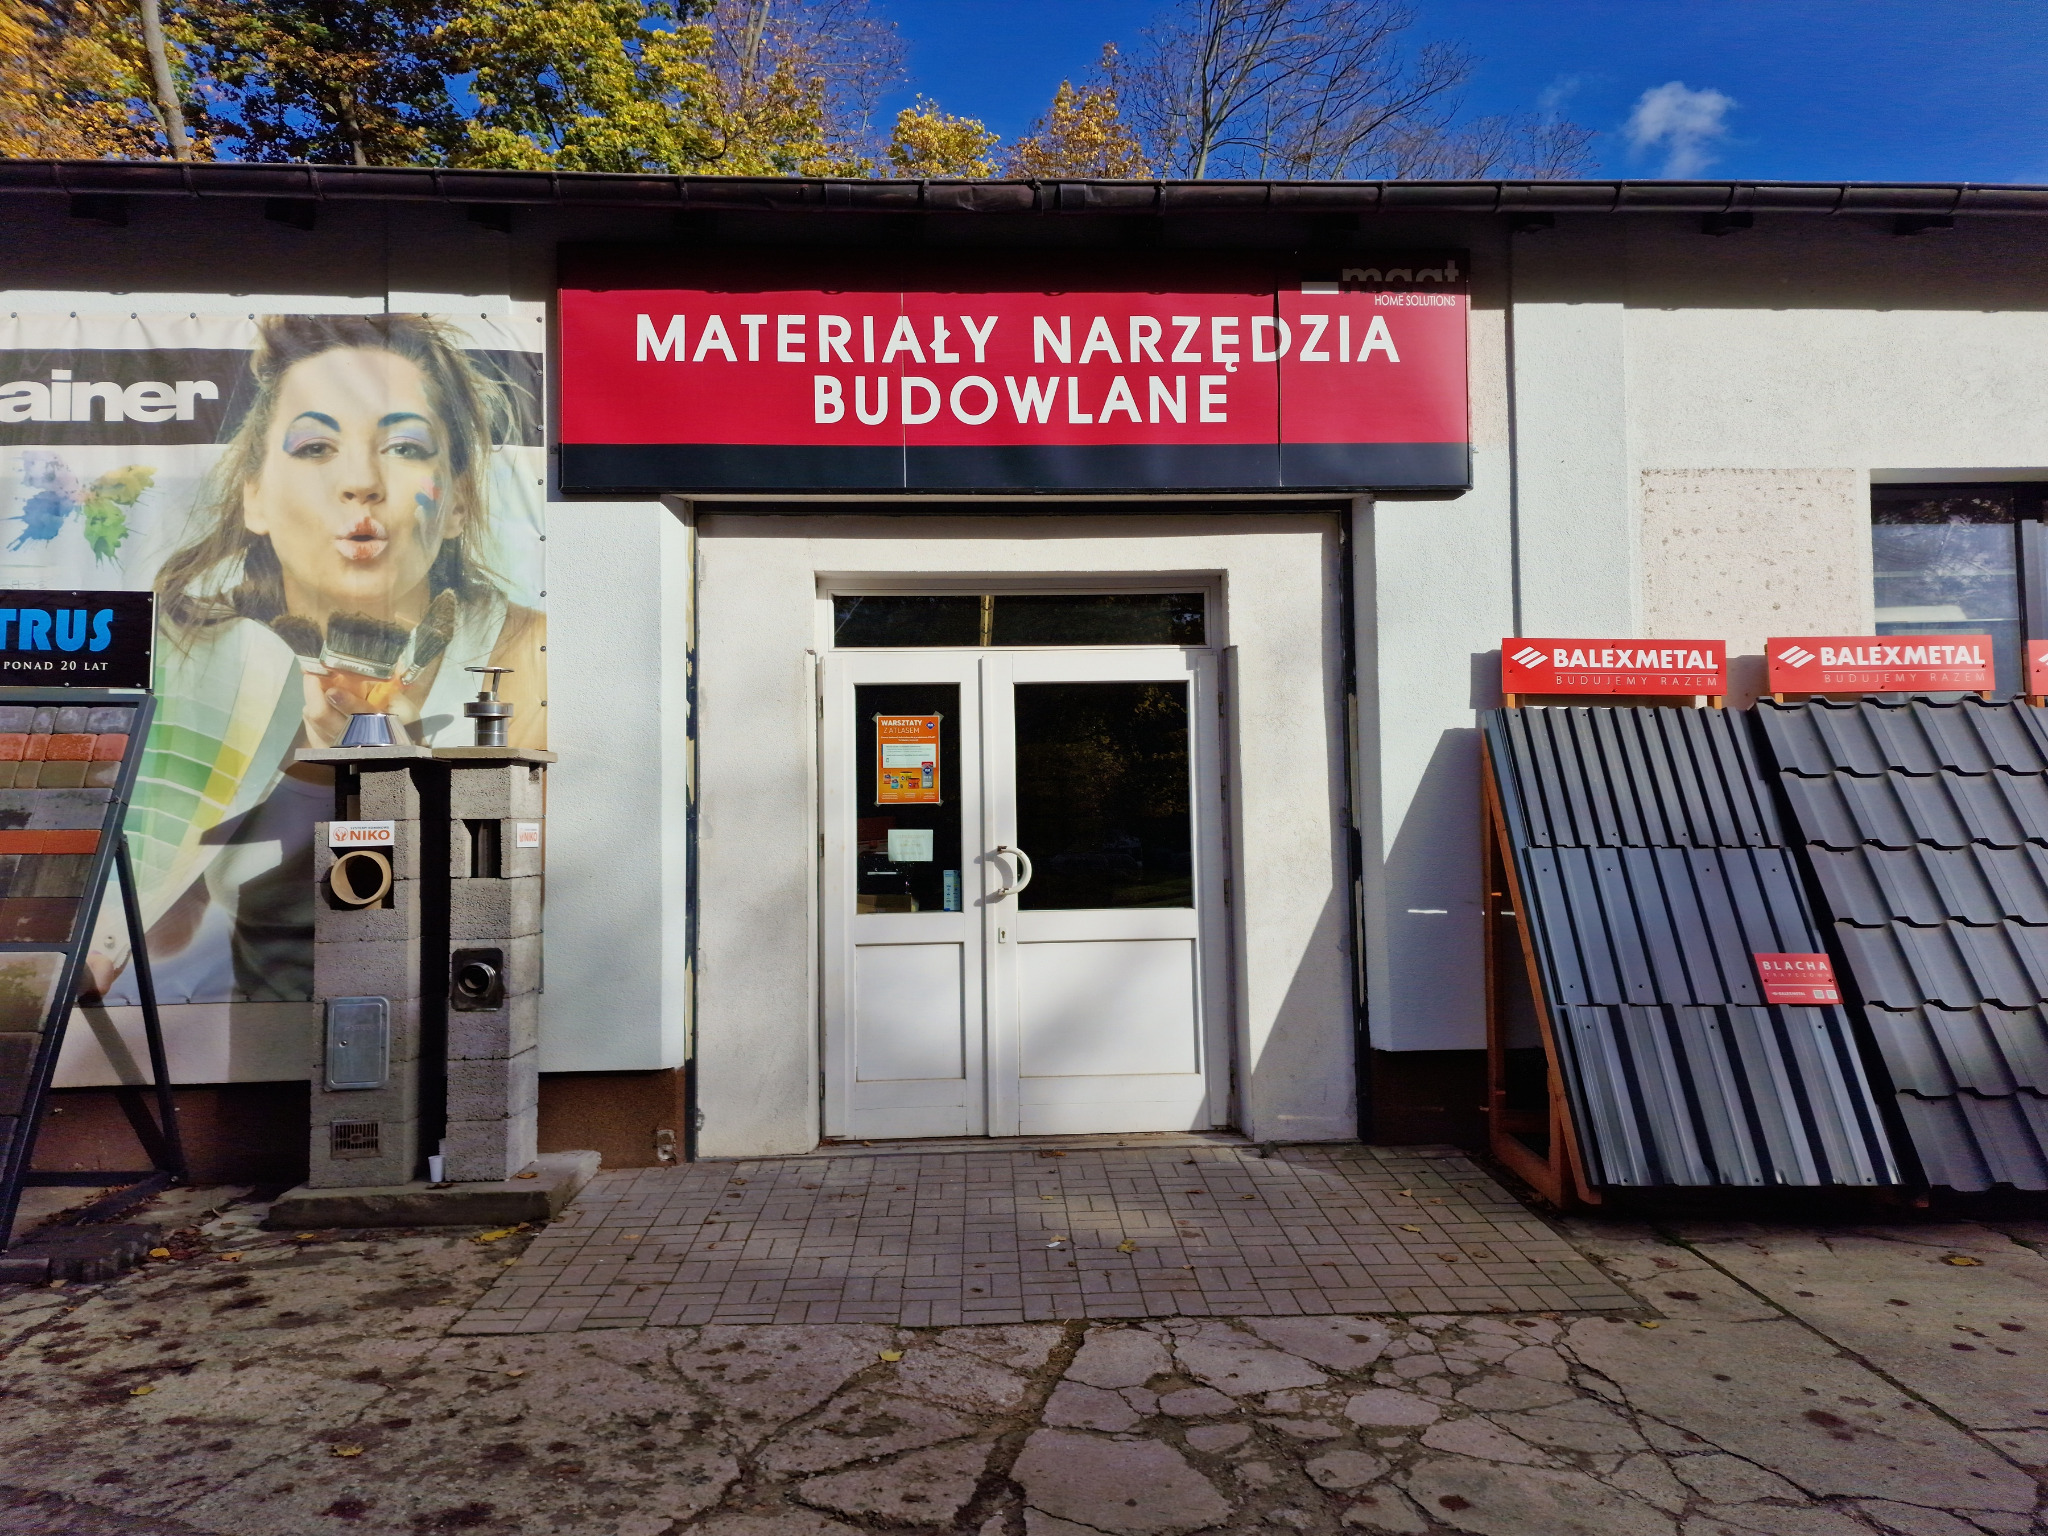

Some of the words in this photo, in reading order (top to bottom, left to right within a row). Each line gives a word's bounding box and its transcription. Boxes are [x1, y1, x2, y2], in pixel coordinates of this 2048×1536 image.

[1374, 294, 1403, 306] HOME
[1406, 294, 1456, 307] SOLUTIONS
[636, 313, 999, 364] MATERIAŁY
[1032, 314, 1401, 373] NARZĘDZIA
[0, 369, 219, 423] ainer
[814, 374, 1228, 425] BUDOWLANE
[1553, 648, 1719, 669] BALEXMETAL
[1820, 645, 1986, 666] BALEXMETAL
[3, 661, 54, 671] PONAD
[60, 660, 77, 671] 20
[84, 661, 109, 671] LAT
[1556, 675, 1648, 686] BUDUJEMY
[1660, 675, 1717, 686] RAZEM
[1824, 672, 1917, 683] BUDUJEMY
[1930, 672, 1986, 682] RAZEM
[350, 830, 391, 841] NIKO
[524, 831, 538, 842] NIKO
[1762, 961, 1828, 971] BLACHA
